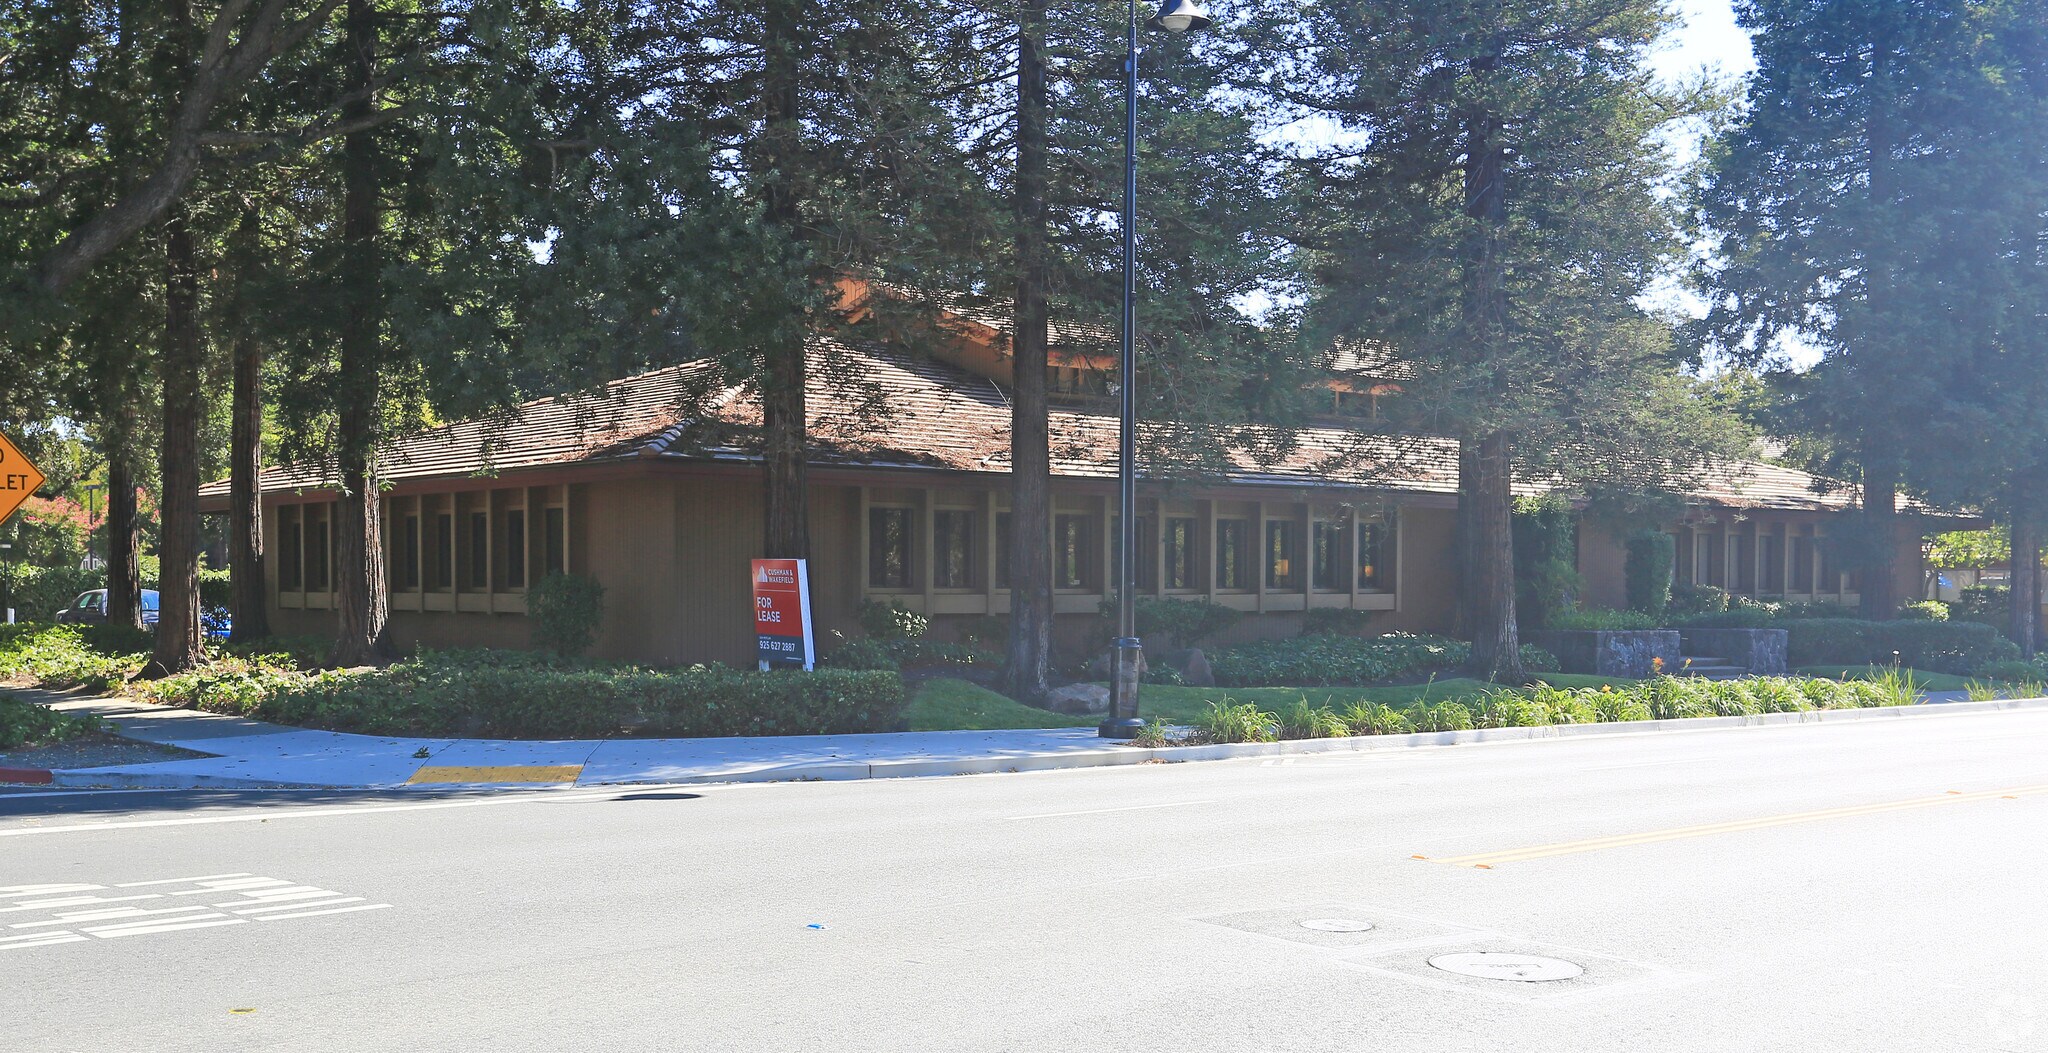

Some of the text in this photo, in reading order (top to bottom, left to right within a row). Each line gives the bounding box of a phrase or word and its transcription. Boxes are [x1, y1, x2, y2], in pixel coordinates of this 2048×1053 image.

[757, 597, 772, 608] FOR
[758, 611, 780, 622] LEASE
[760, 641, 795, 651] 925 627 2887
